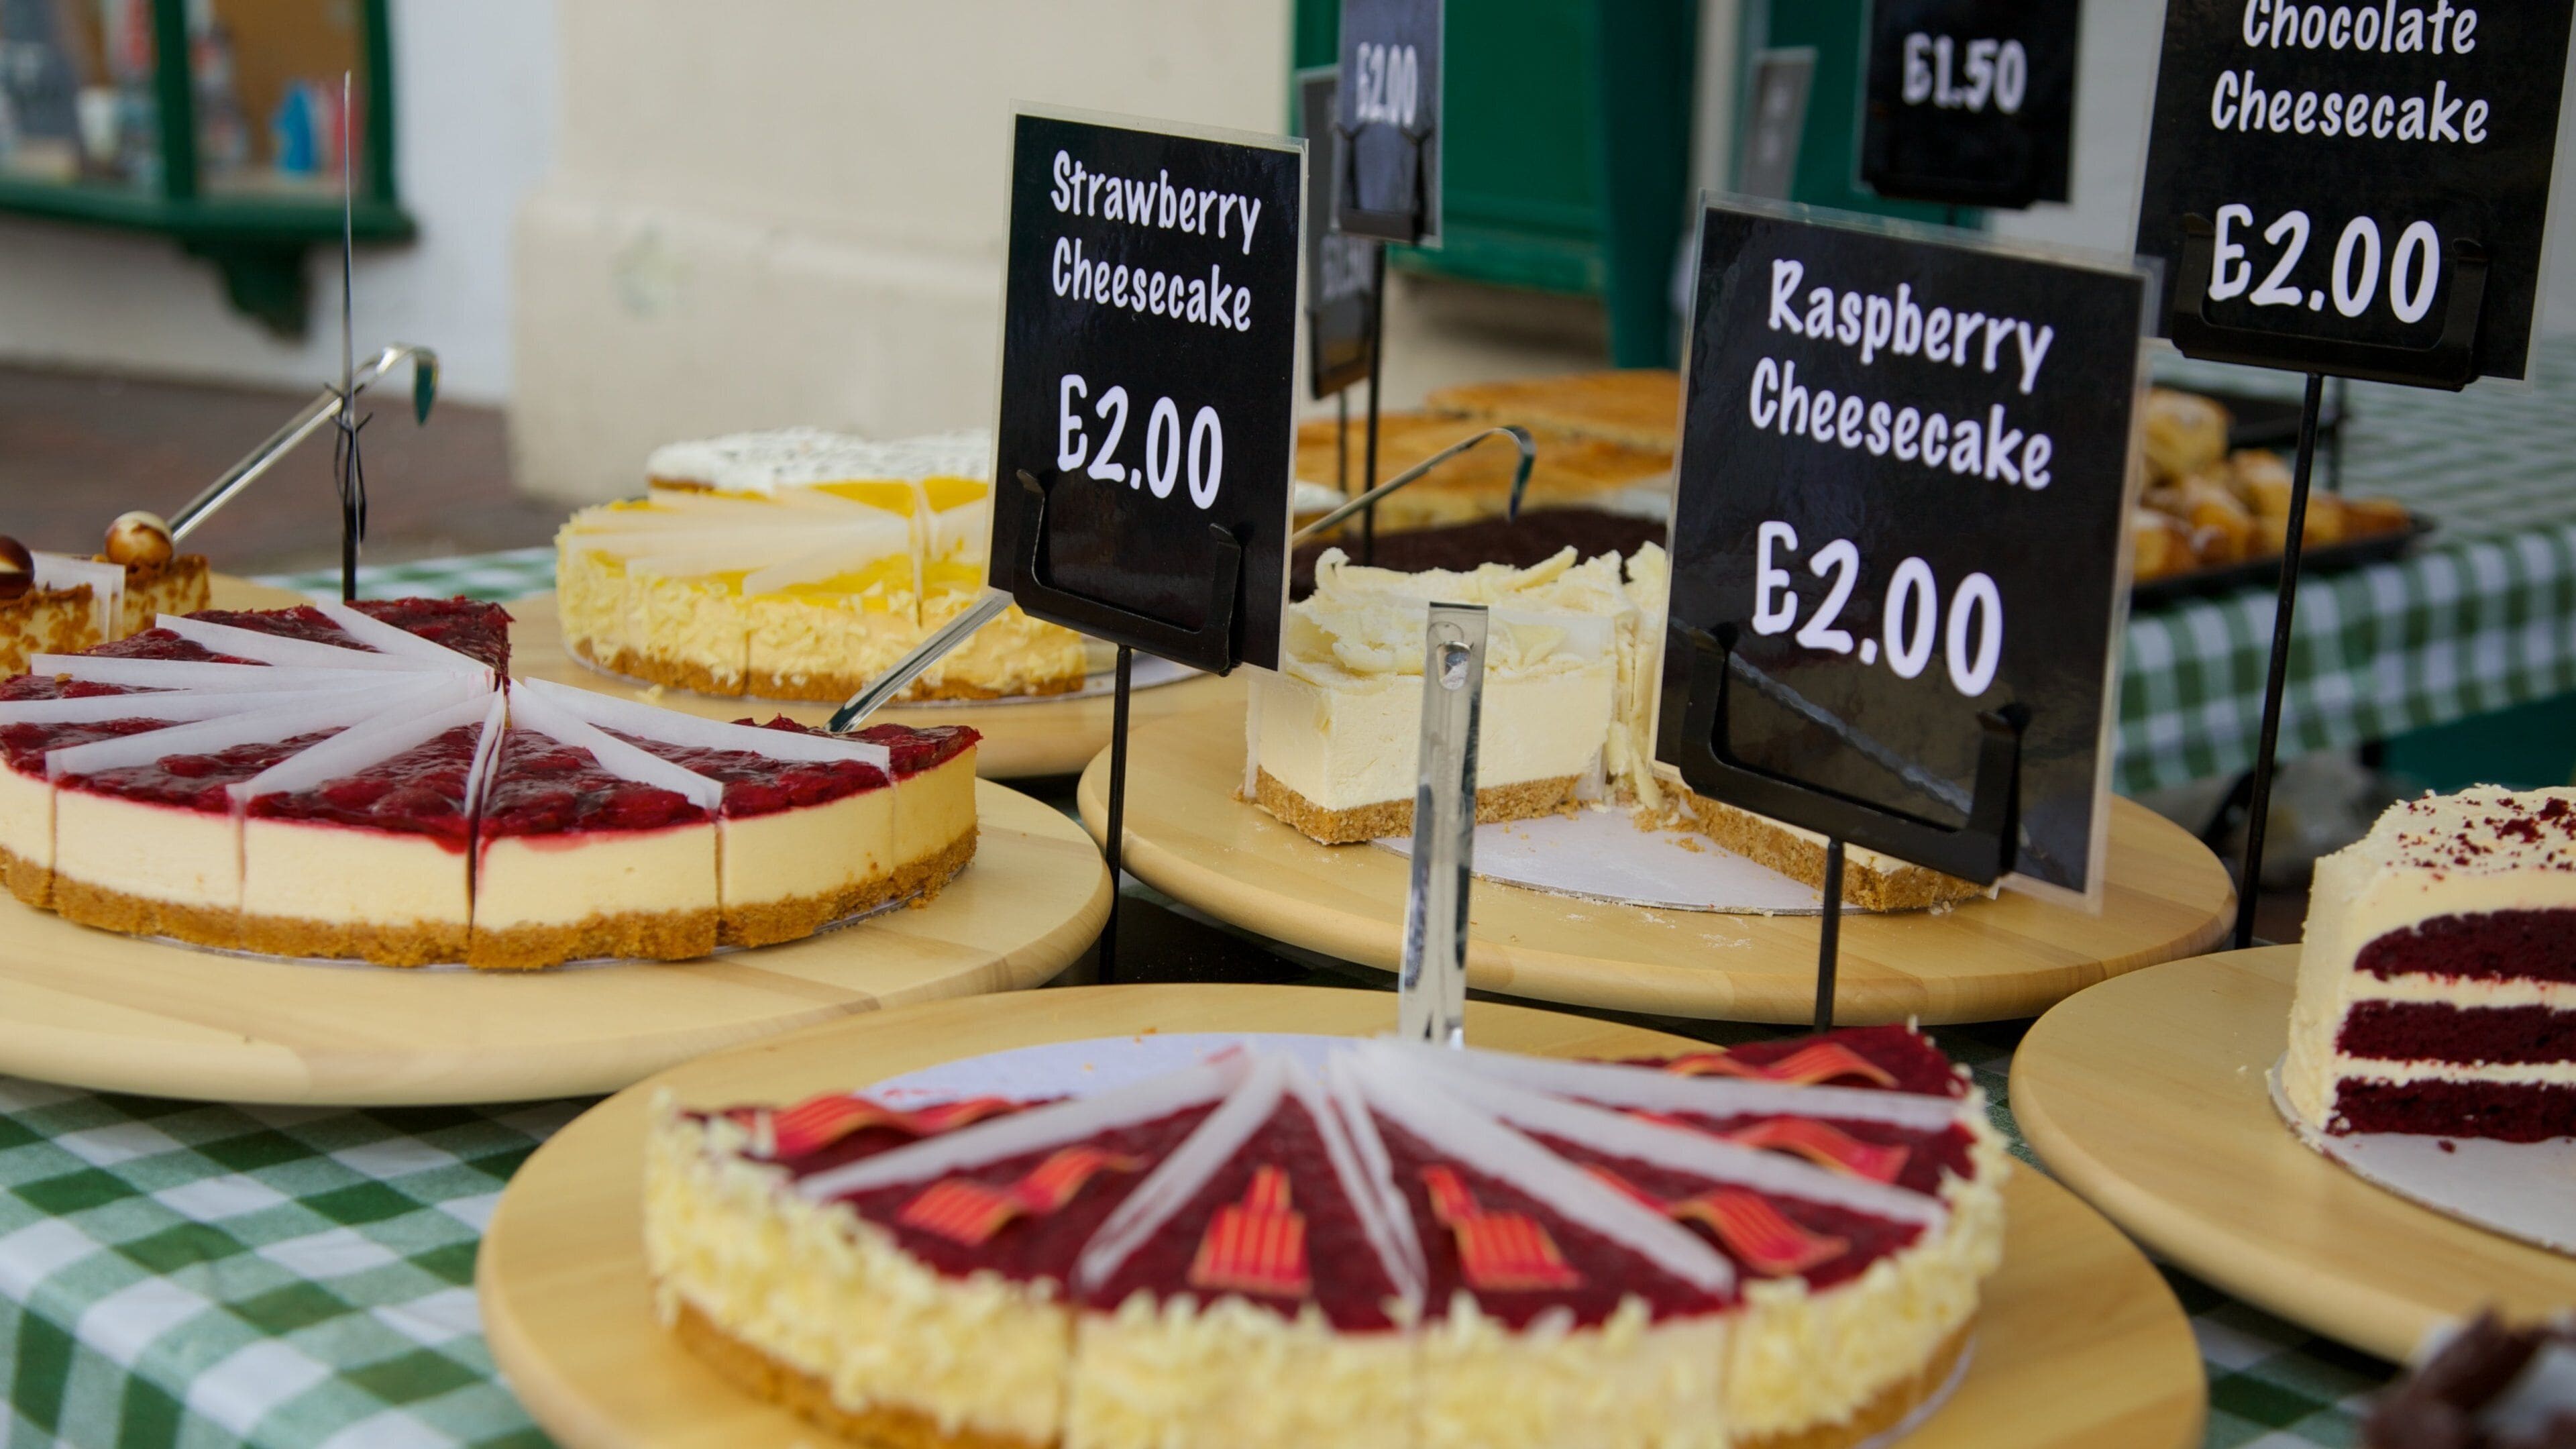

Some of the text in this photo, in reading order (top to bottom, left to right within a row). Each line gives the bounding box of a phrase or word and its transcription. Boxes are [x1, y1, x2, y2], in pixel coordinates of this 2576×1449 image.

[2243, 0, 2477, 54] Chocolate
[2212, 69, 2489, 144] Cheesecake
[1050, 149, 1262, 256] Strawberry
[1052, 236, 1251, 332] Cheesecake
[2208, 203, 2440, 324] £2.00
[1768, 258, 2053, 394] Raspberry
[1057, 374, 1224, 510] £2.00
[1750, 356, 2052, 490] Cheesecake
[1751, 521, 2002, 697] £2.00
